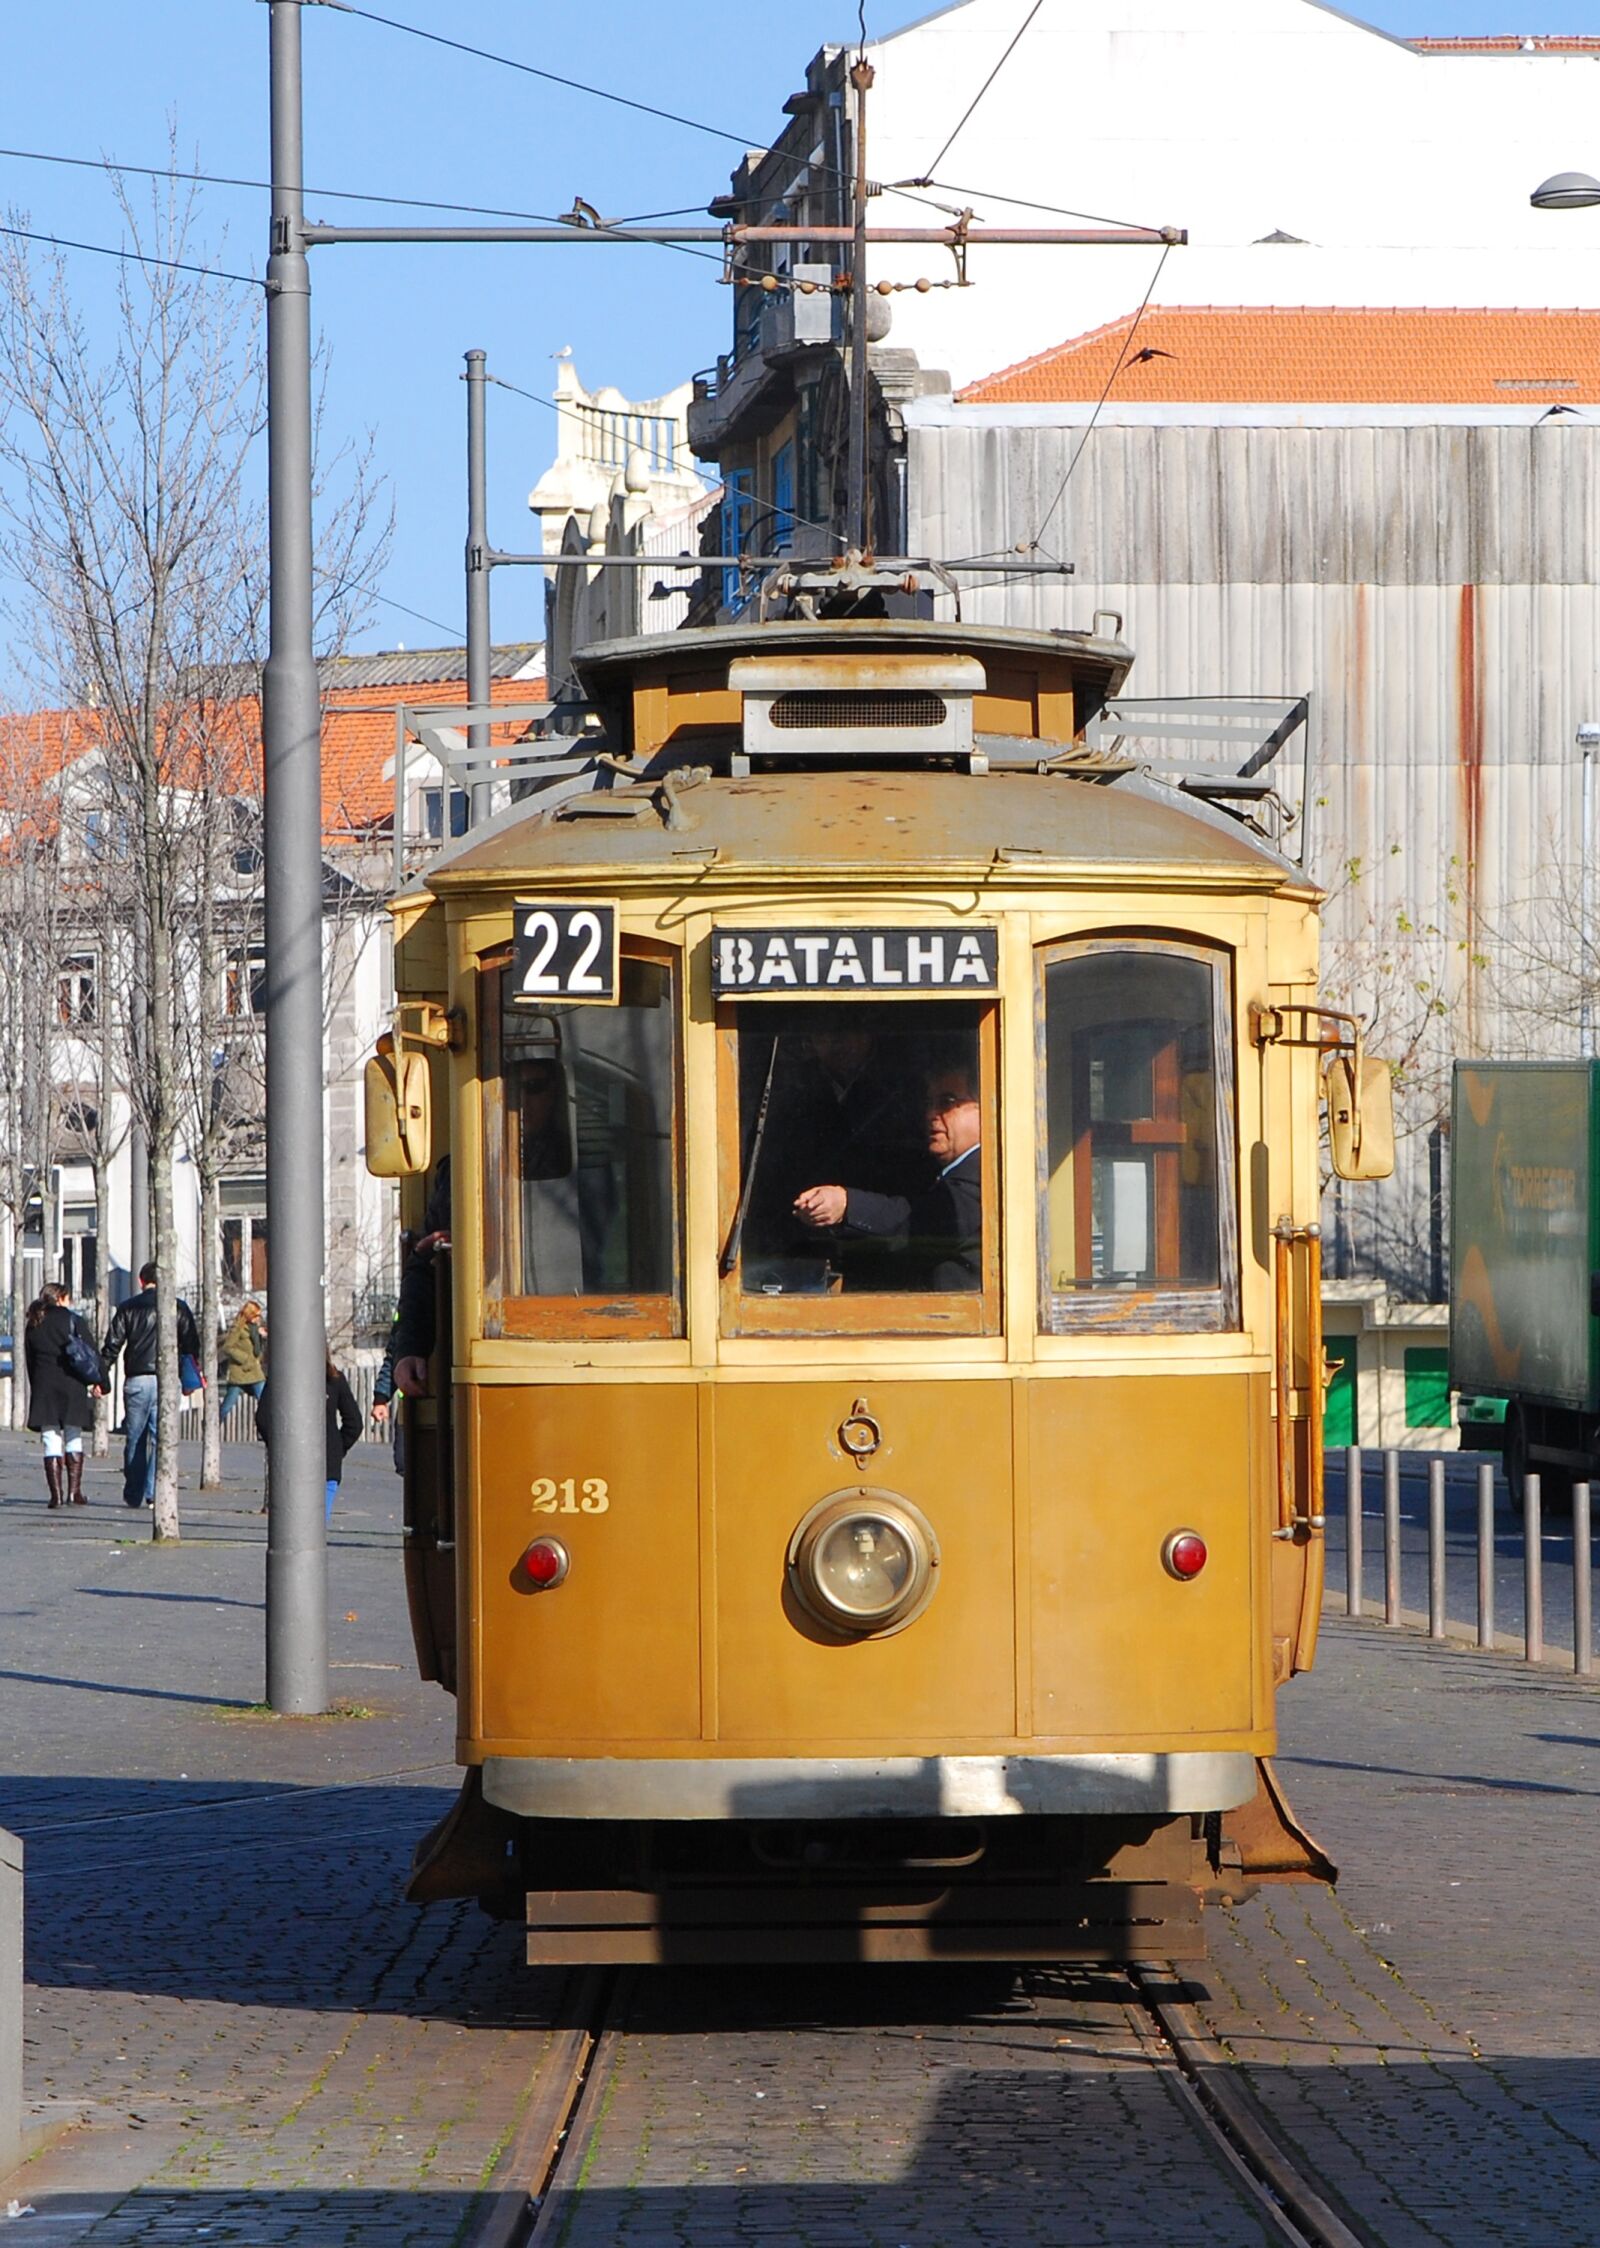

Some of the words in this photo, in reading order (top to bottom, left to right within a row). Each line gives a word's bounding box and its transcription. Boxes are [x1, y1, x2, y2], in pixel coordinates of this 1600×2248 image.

[524, 911, 602, 991] 22
[719, 935, 990, 985] BATALHA
[531, 1478, 609, 1513] 213
